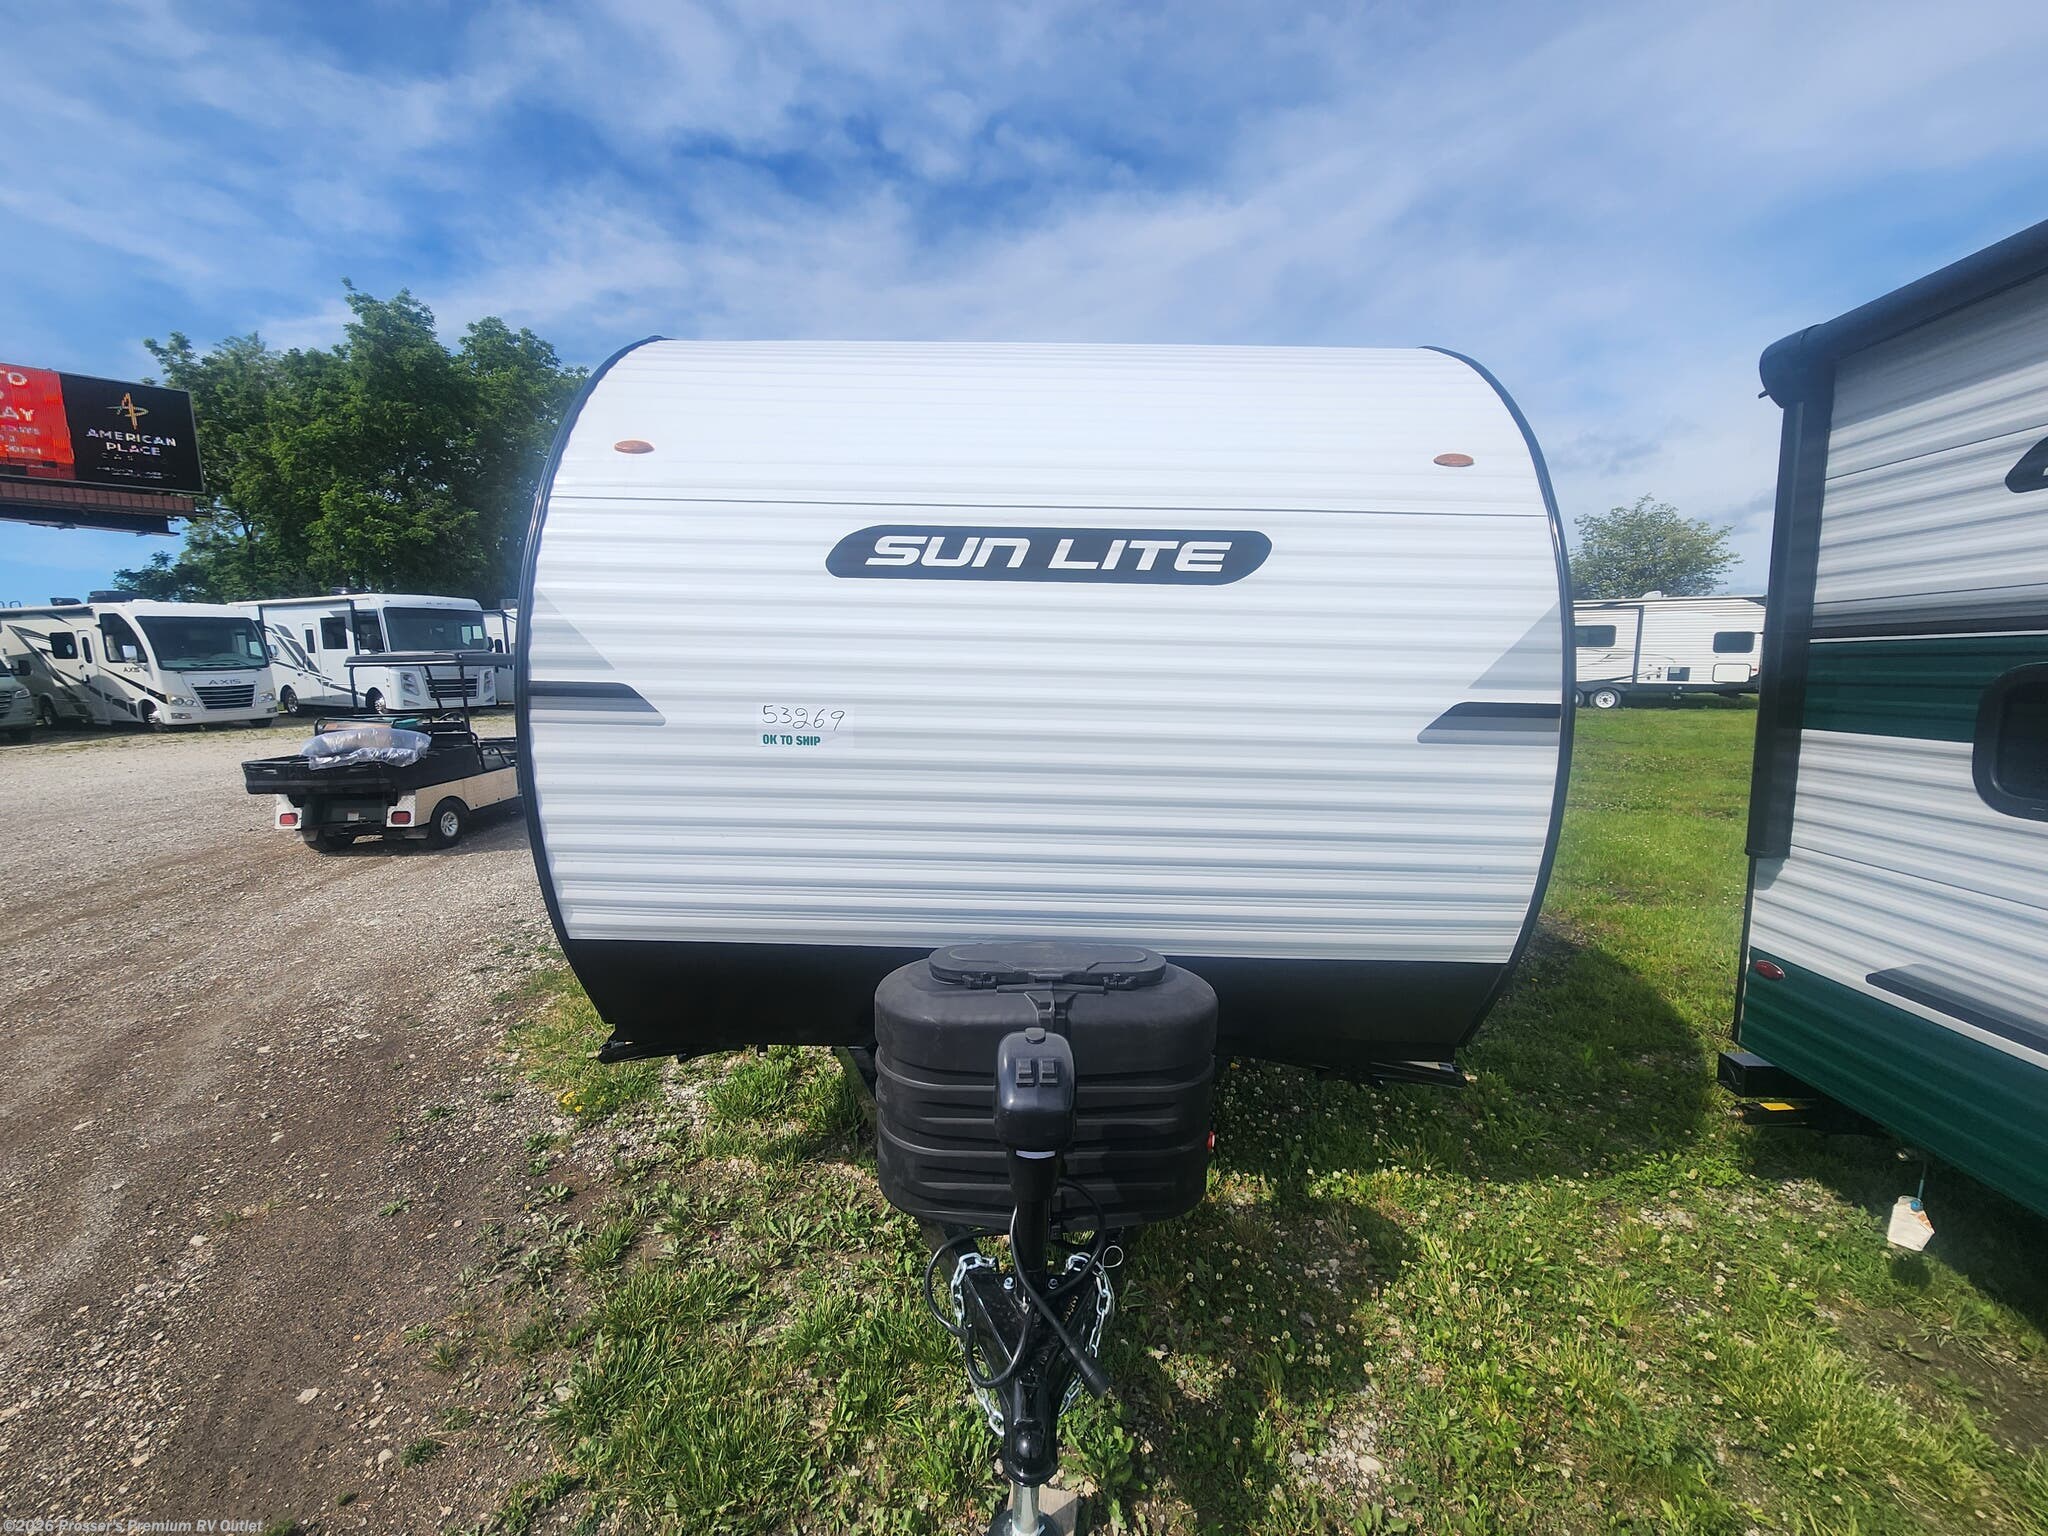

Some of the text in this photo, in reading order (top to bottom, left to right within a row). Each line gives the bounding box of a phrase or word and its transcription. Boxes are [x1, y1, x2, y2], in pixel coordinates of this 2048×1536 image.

[86, 428, 177, 447] AMERICAN
[106, 442, 161, 456] PLACE
[865, 535, 1232, 572] SUN LITE
[762, 704, 846, 731] 53269
[762, 734, 821, 746] OK TO SHIP
